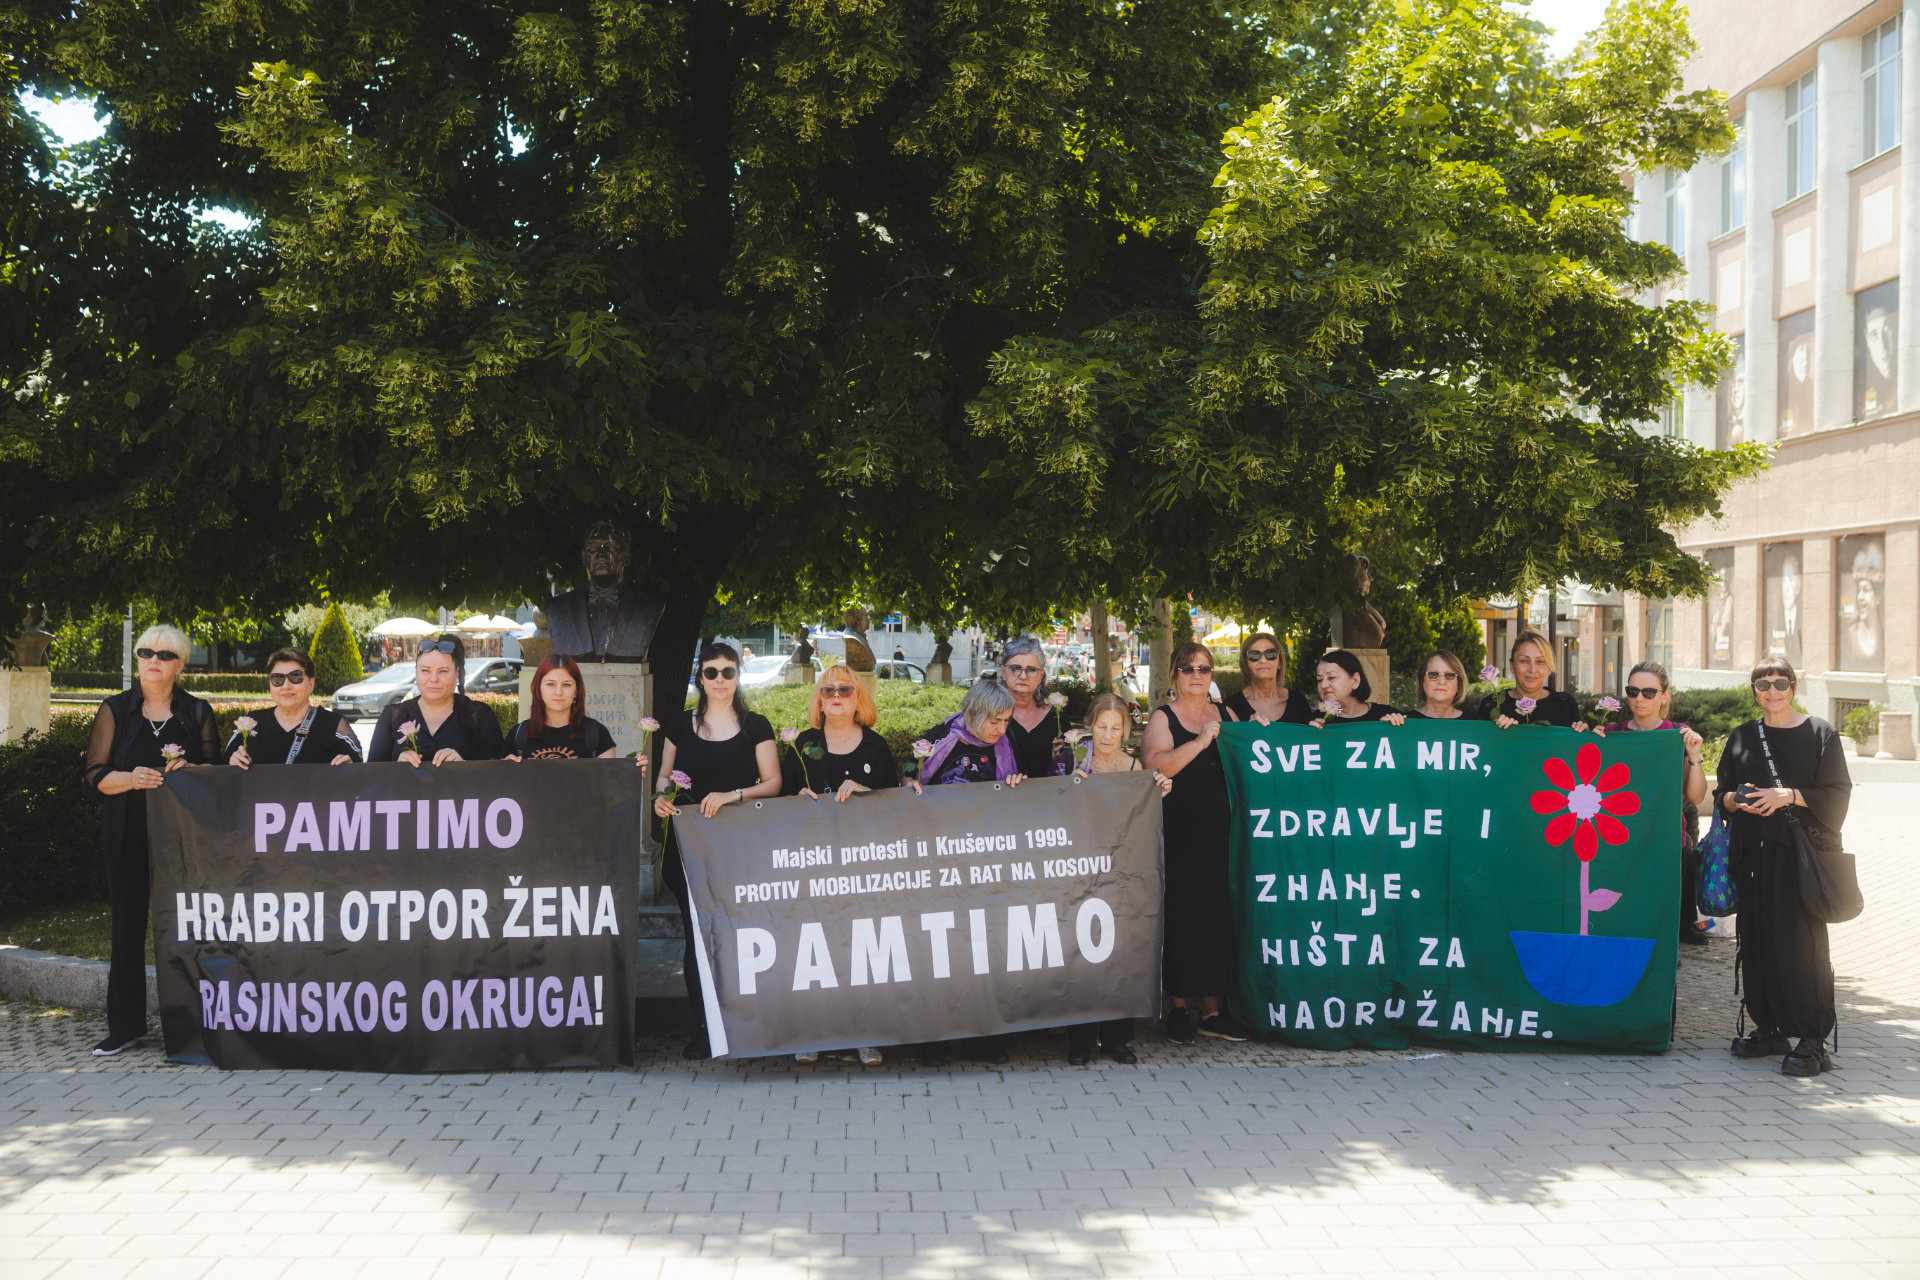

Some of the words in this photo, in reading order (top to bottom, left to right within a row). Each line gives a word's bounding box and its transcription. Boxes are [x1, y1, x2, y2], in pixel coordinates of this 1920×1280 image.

[1250, 740, 1321, 773] SVE
[1346, 737, 1396, 769] ZA
[1417, 740, 1492, 777] MIR,
[254, 797, 524, 853] PAMTIMO
[772, 846, 832, 869] Majski
[841, 839, 908, 865] protesti
[916, 840, 928, 857] u
[936, 833, 1017, 856] Kruševcu
[1025, 827, 1073, 848] 1999.
[1480, 809, 1491, 839] I
[735, 880, 799, 904] PROTIV
[809, 870, 932, 898] MOBILIZACIJE
[939, 867, 962, 887] ZA
[969, 864, 1003, 885] RAT
[1010, 861, 1036, 881] NA
[1043, 856, 1112, 879] KOSOVU
[176, 891, 324, 943] HRABRI
[340, 888, 490, 942] OTPOR
[502, 876, 619, 938] ŽENA
[736, 897, 1116, 995] PAMTIMO
[1261, 921, 1386, 966] NIŠTA
[1419, 937, 1466, 968] ZA
[200, 979, 407, 1033] RASINSKOG
[421, 975, 604, 1031] OKRUGA!
